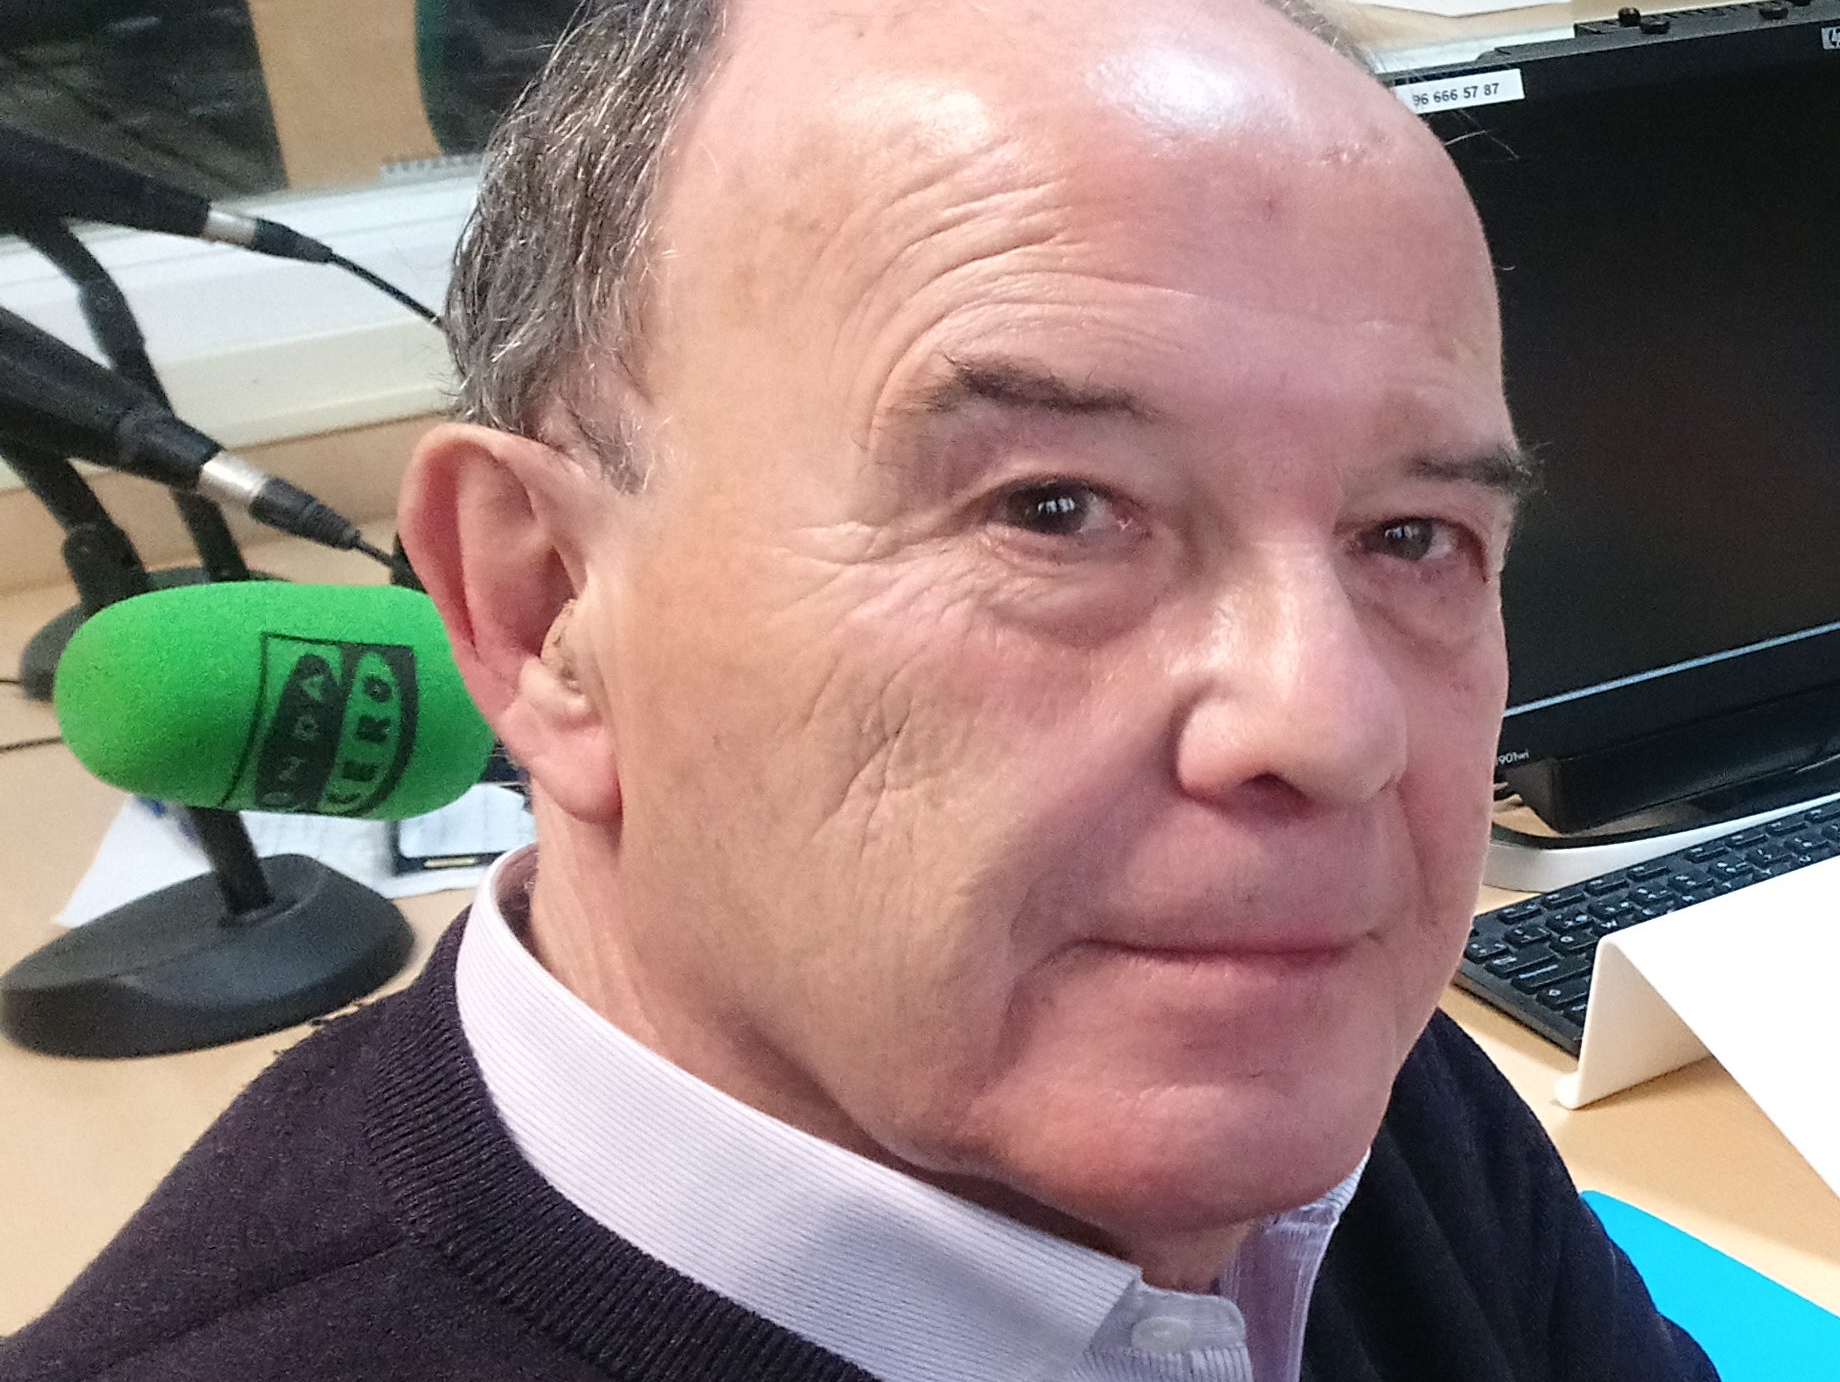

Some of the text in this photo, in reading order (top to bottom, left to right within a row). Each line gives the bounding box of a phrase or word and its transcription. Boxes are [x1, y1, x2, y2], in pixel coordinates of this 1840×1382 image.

[1412, 82, 1500, 106] 96 666 57 87
